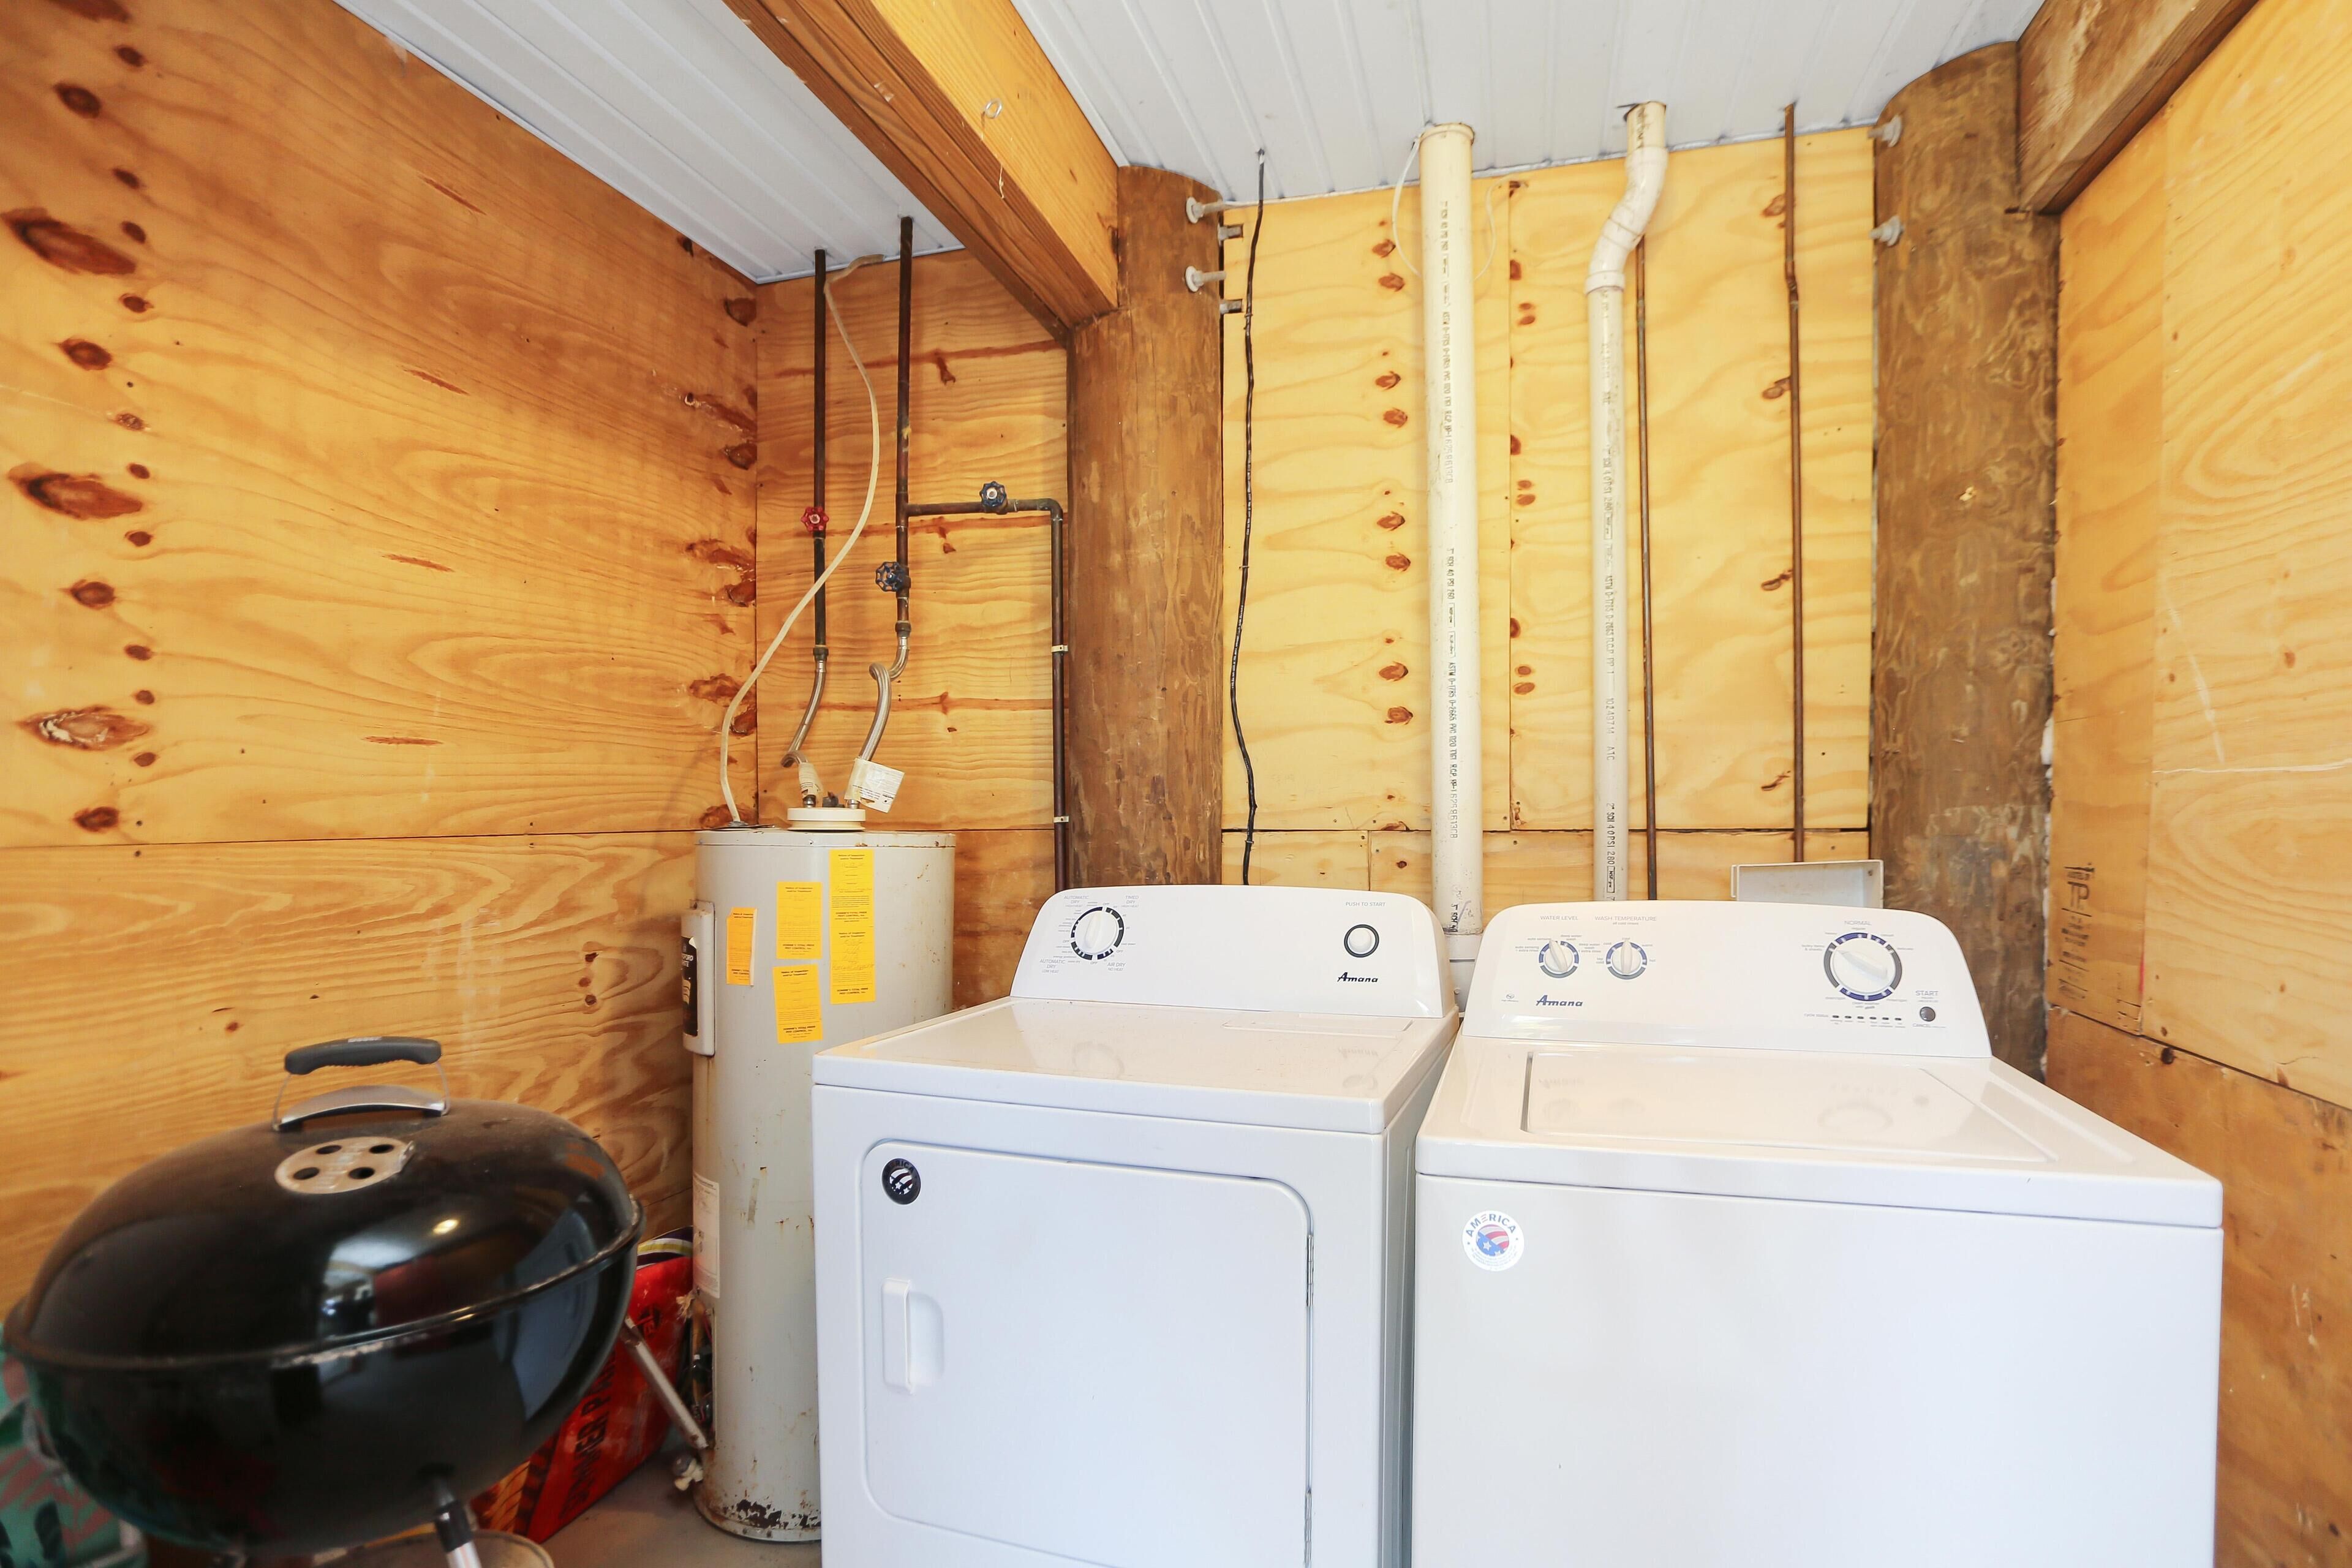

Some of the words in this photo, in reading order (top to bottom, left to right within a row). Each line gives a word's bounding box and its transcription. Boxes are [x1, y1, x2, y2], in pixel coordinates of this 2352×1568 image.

[1337, 971, 1379, 982] Amana
[1536, 995, 1583, 1007] Amana
[1466, 1213, 1516, 1238] AMERICA
